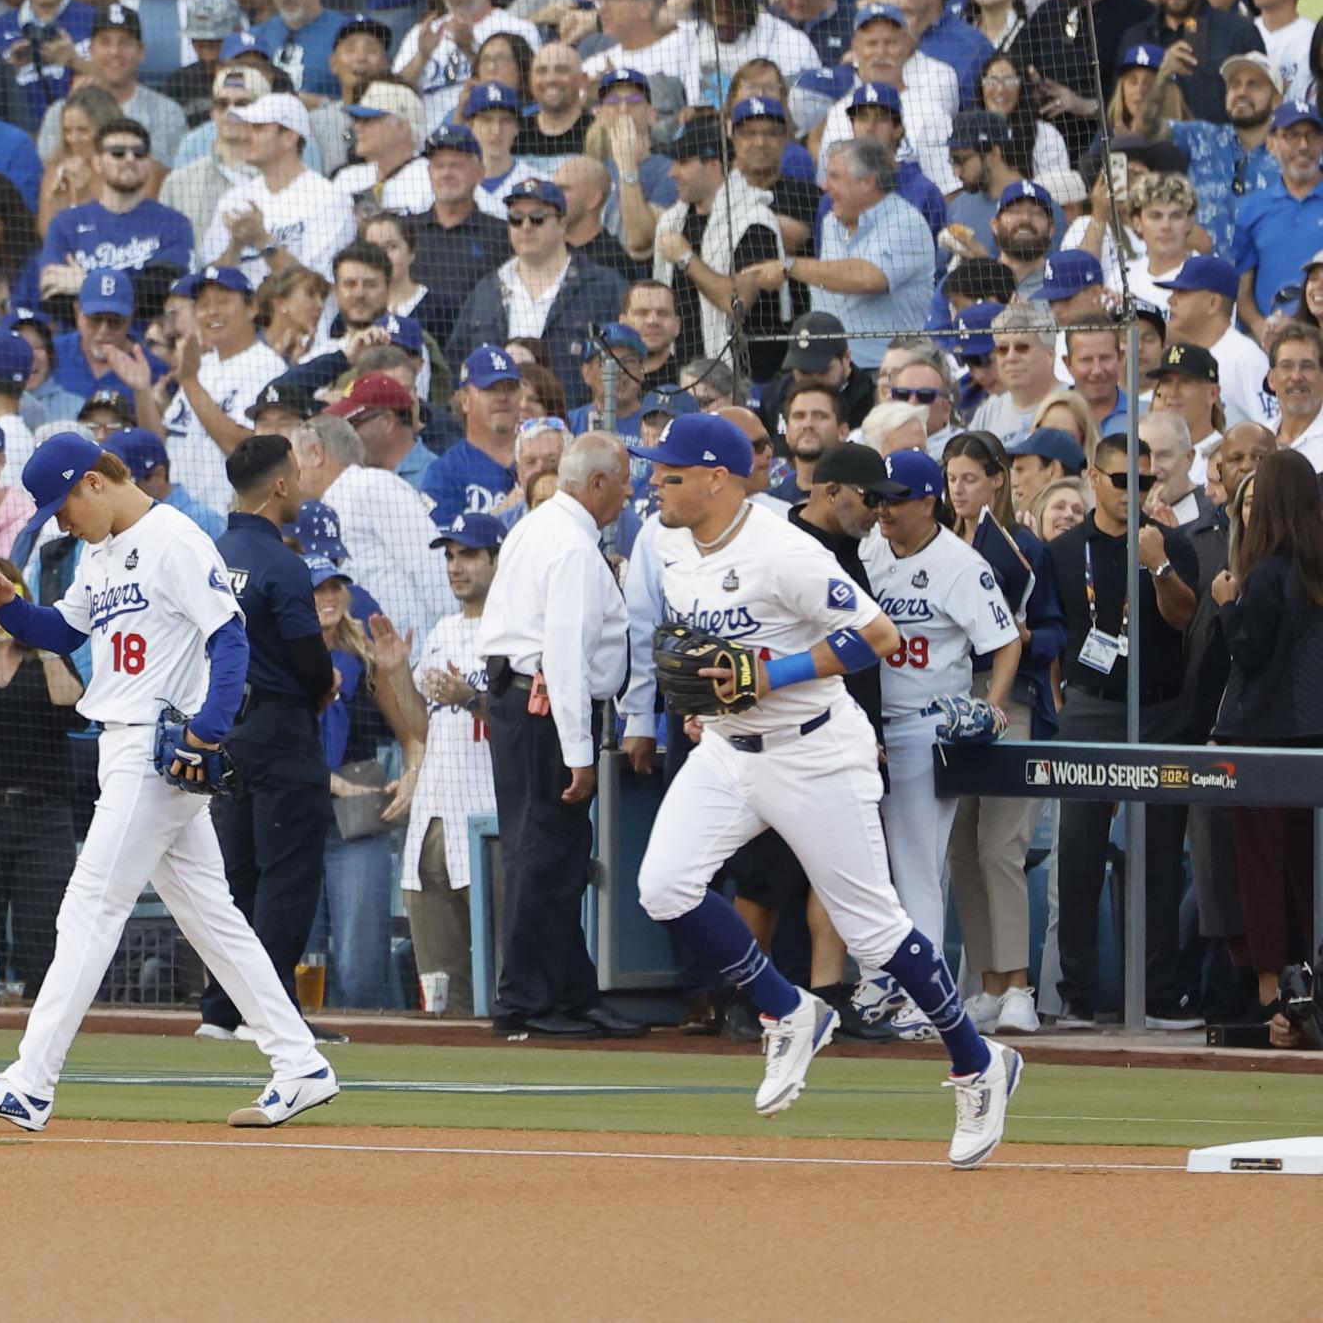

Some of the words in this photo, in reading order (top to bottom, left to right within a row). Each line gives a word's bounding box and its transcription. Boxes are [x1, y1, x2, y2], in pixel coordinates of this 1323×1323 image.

[85, 582, 149, 635] Dodgers
[988, 600, 1009, 630] LA
[111, 631, 147, 675] 18
[1052, 761, 1105, 786] WORLD
[1108, 763, 1159, 790] SERIES
[1160, 769, 1189, 784] 2024
